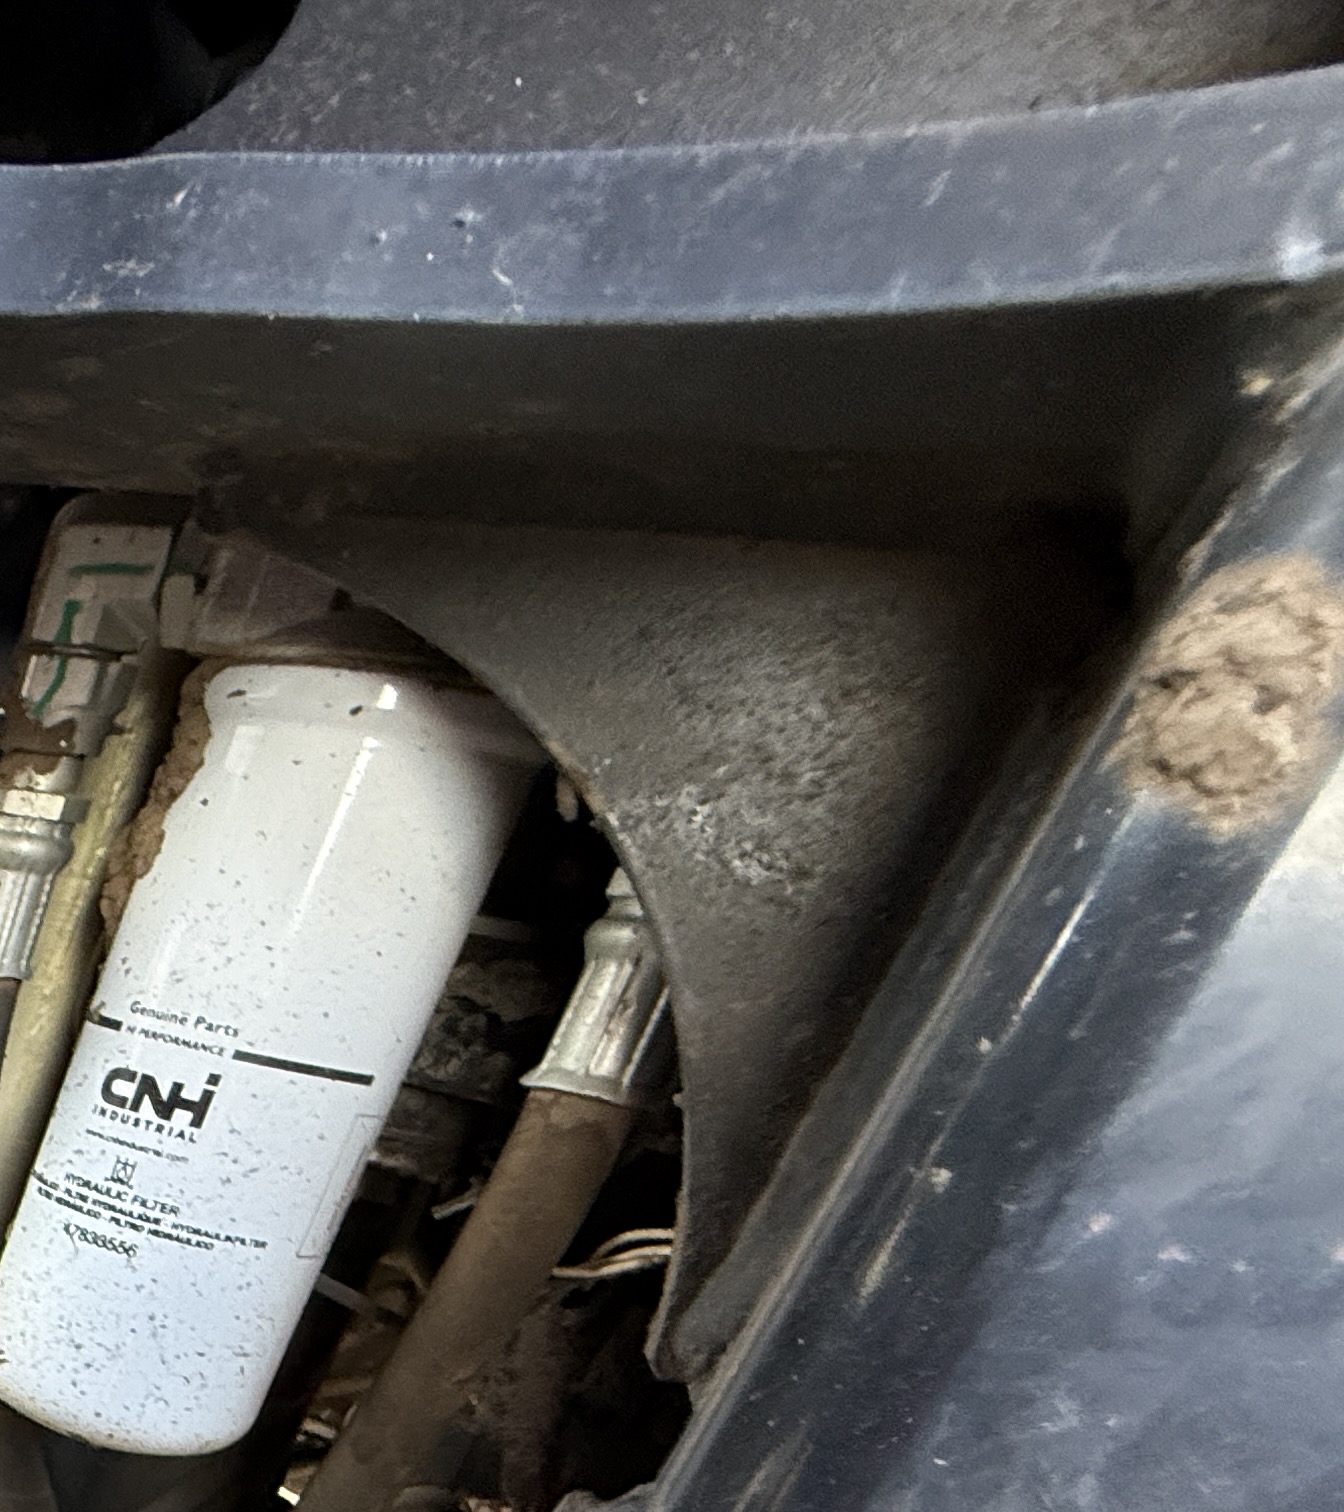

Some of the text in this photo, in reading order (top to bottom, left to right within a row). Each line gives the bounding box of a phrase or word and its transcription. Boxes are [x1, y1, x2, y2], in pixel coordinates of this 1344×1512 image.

[130, 1000, 240, 1038] Genuine Parts
[92, 1103, 197, 1144] INDUSTRIAL
[64, 1171, 129, 1203] HYDRAULIC
[130, 1194, 180, 1217] FILTER
